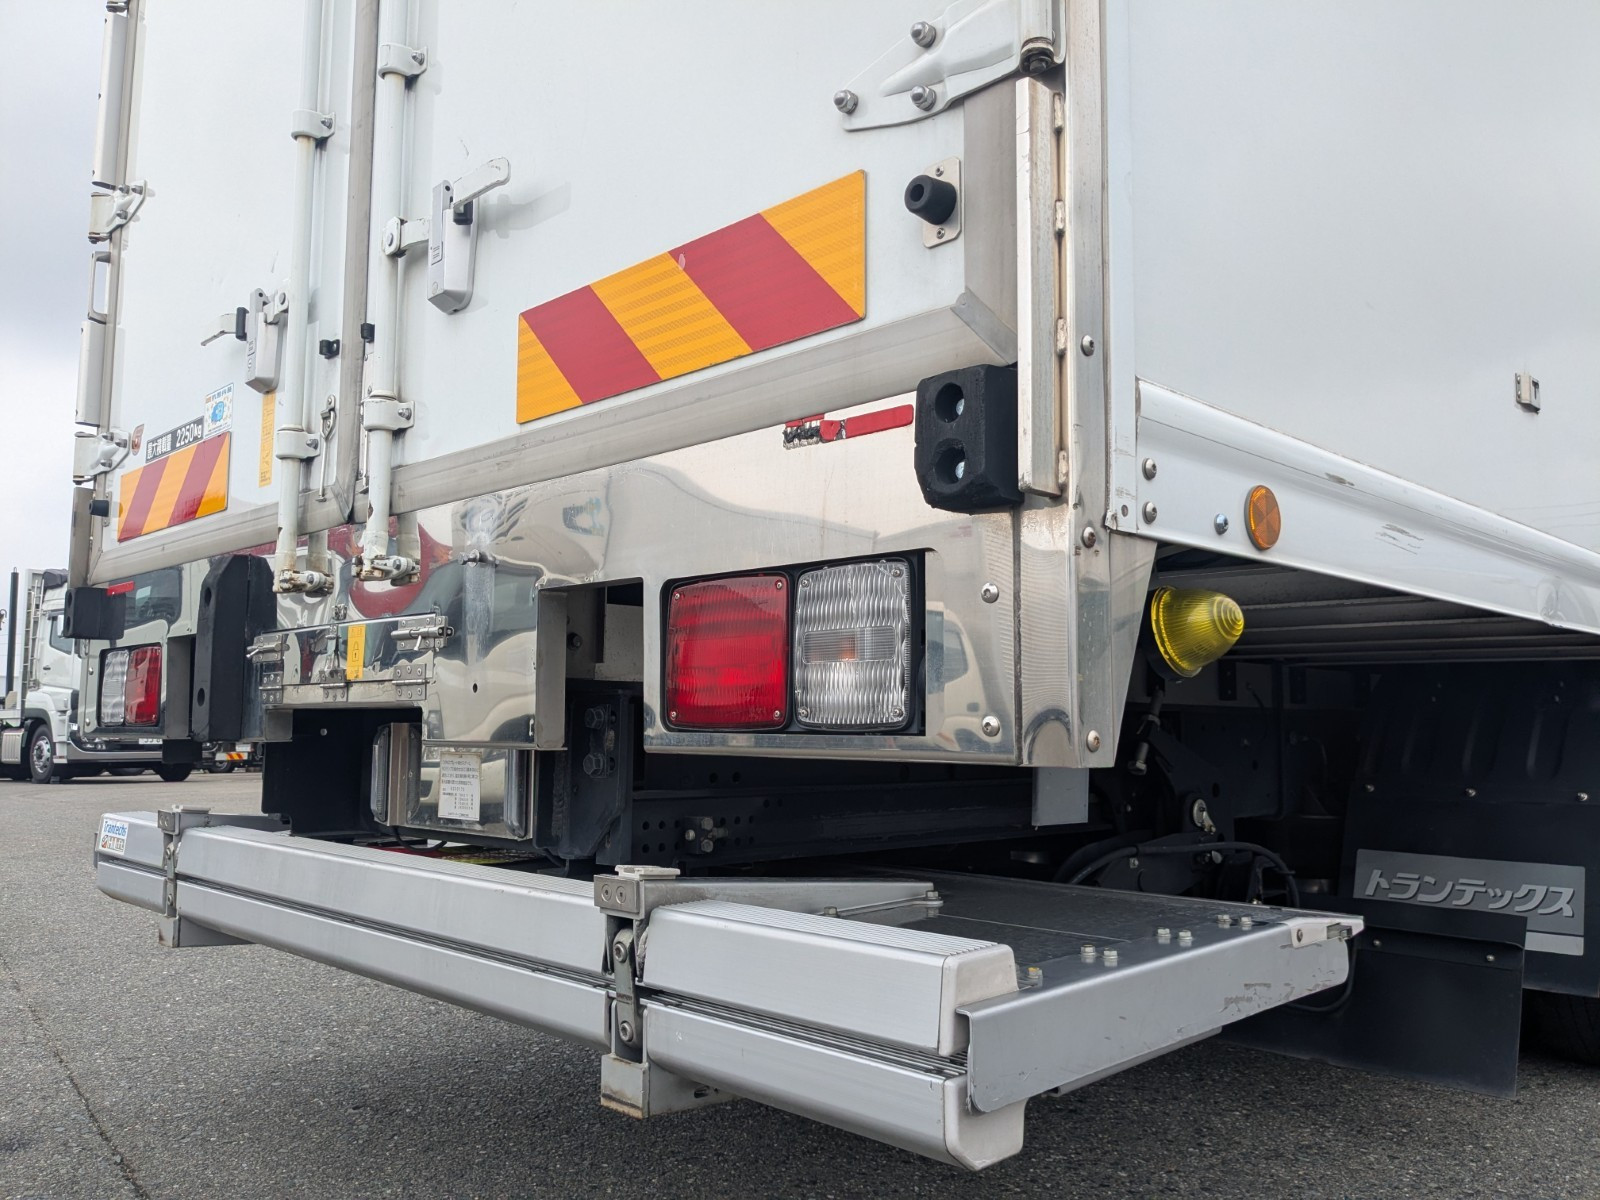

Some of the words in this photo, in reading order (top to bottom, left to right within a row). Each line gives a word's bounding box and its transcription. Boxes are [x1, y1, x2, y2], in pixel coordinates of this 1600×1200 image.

[176, 423, 202, 448] 2250kg
[1364, 869, 1576, 918] トランテックス
